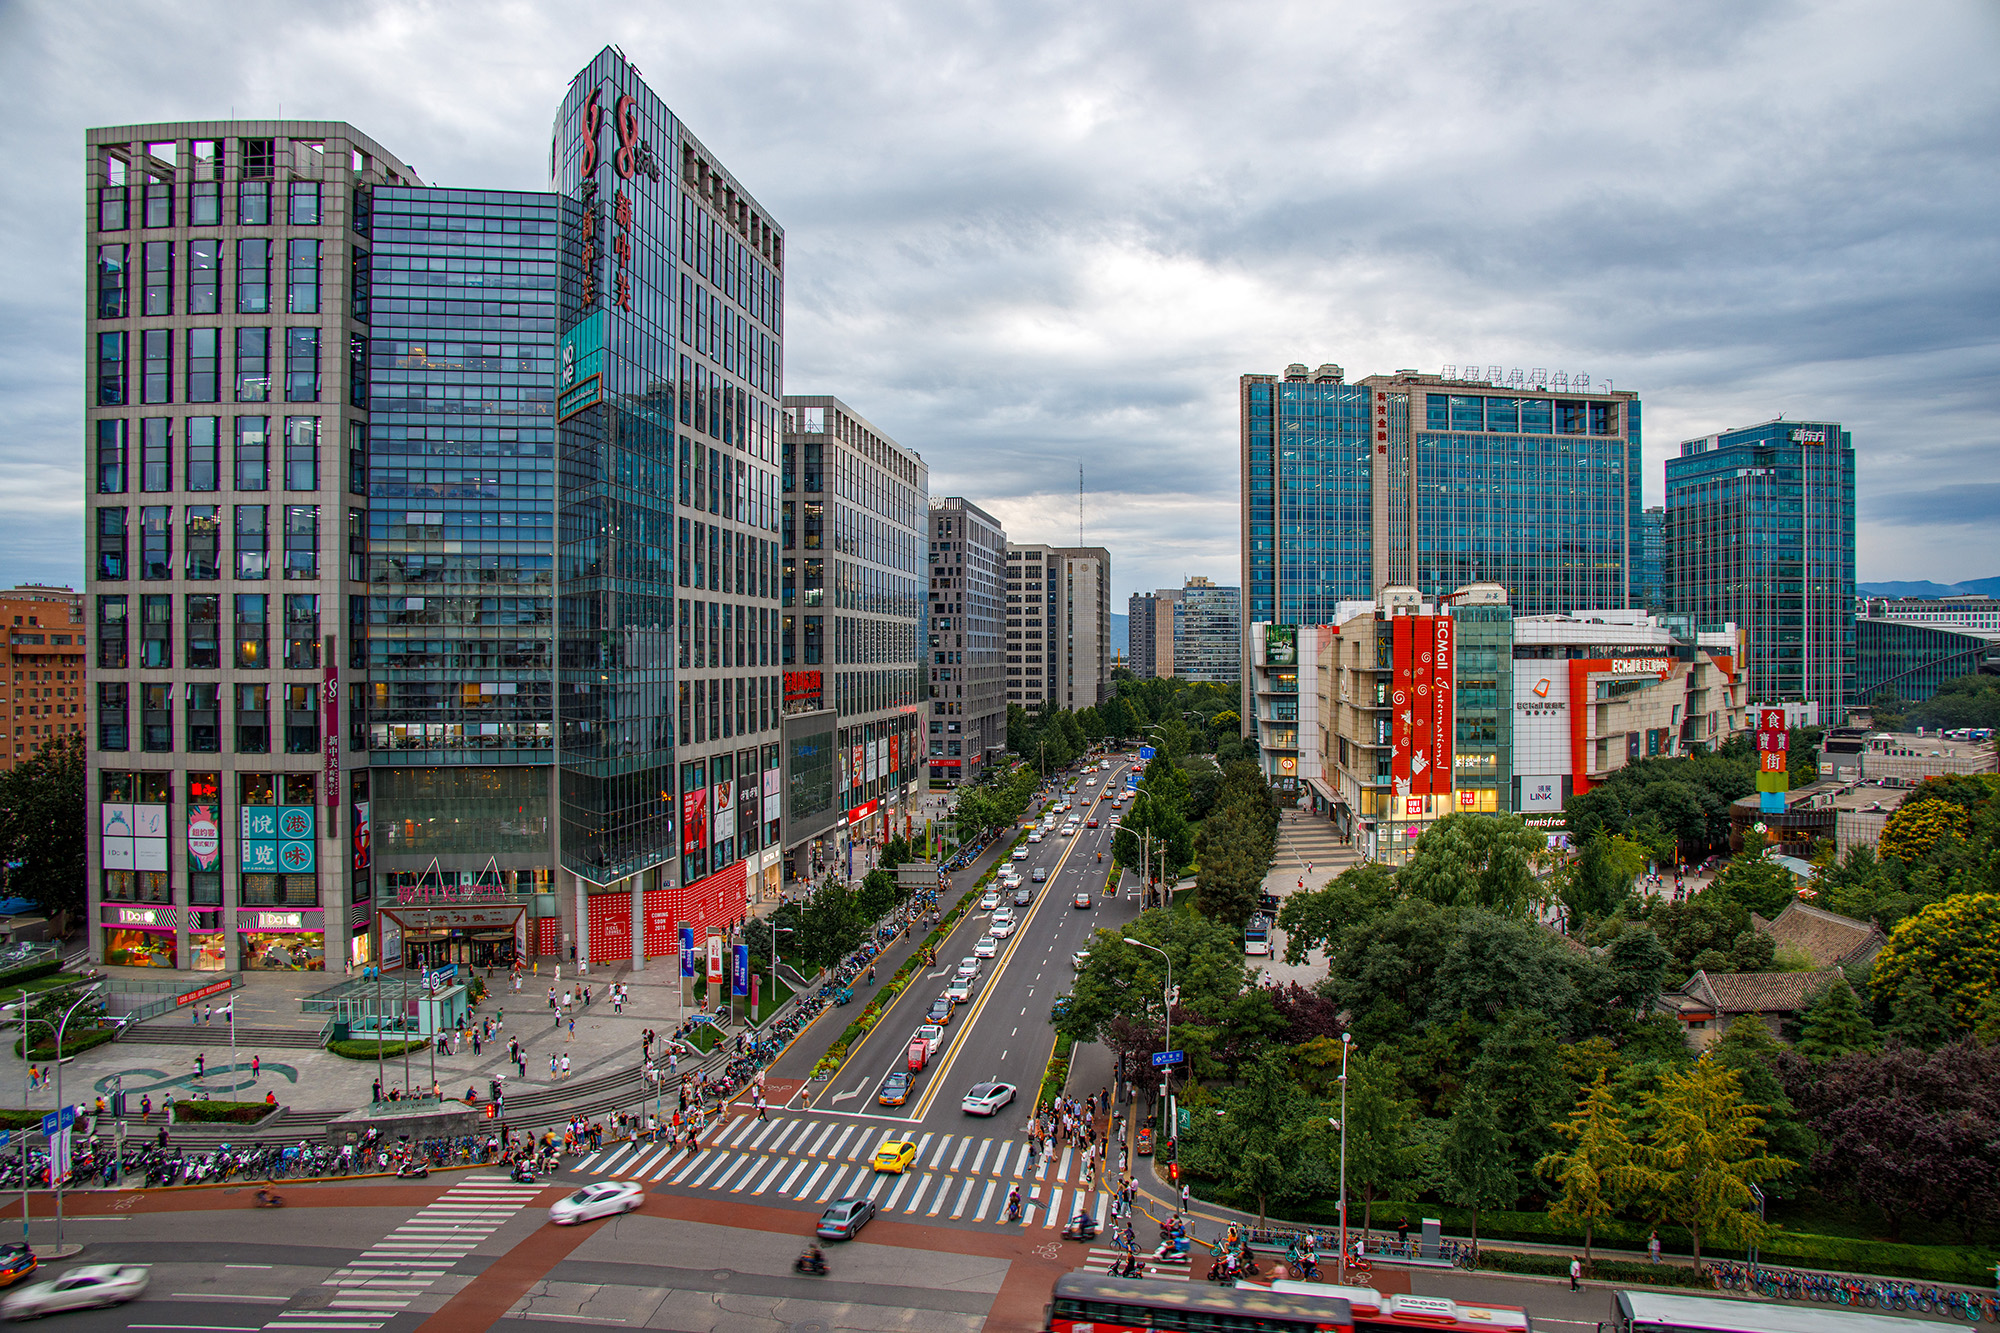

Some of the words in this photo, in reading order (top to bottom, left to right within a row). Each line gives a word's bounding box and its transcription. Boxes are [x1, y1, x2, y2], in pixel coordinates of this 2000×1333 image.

[612, 188, 632, 313] 新中关
[1792, 429, 1825, 445] 新东方
[1437, 621, 1448, 669] ECMall
[1435, 676, 1449, 769] International
[329, 735, 338, 768] 新中关
[1530, 793, 1552, 801] LINK
[397, 884, 457, 903] 新中关
